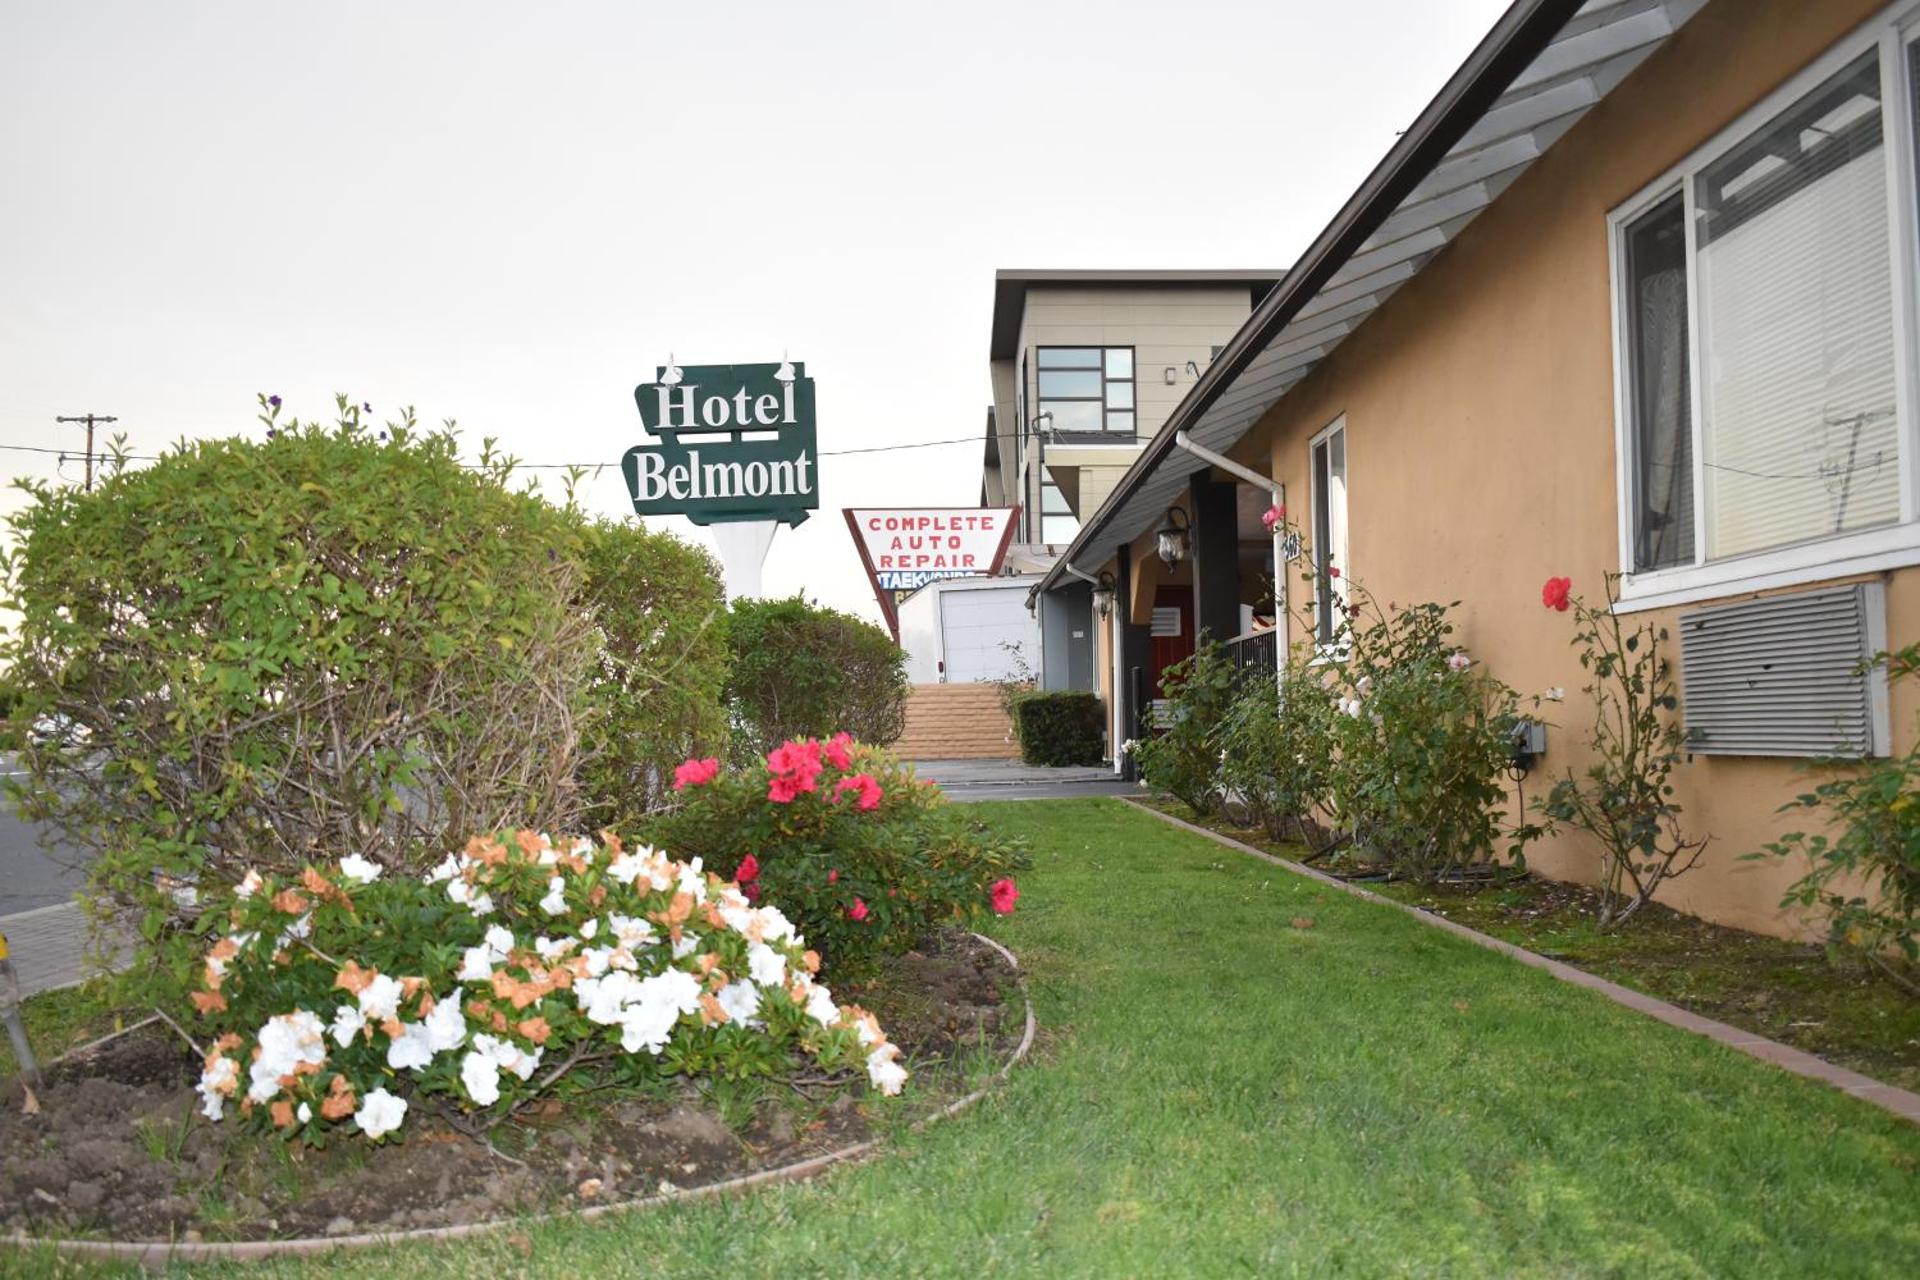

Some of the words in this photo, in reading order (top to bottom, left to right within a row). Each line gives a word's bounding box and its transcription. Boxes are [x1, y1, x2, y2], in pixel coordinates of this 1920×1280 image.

[653, 383, 797, 428] Hotel
[633, 450, 812, 501] Belmont
[869, 517, 994, 531] COMPLETE
[891, 536, 961, 550] AUTO
[880, 554, 975, 568] REPAIR
[880, 571, 975, 589] TAEKW
